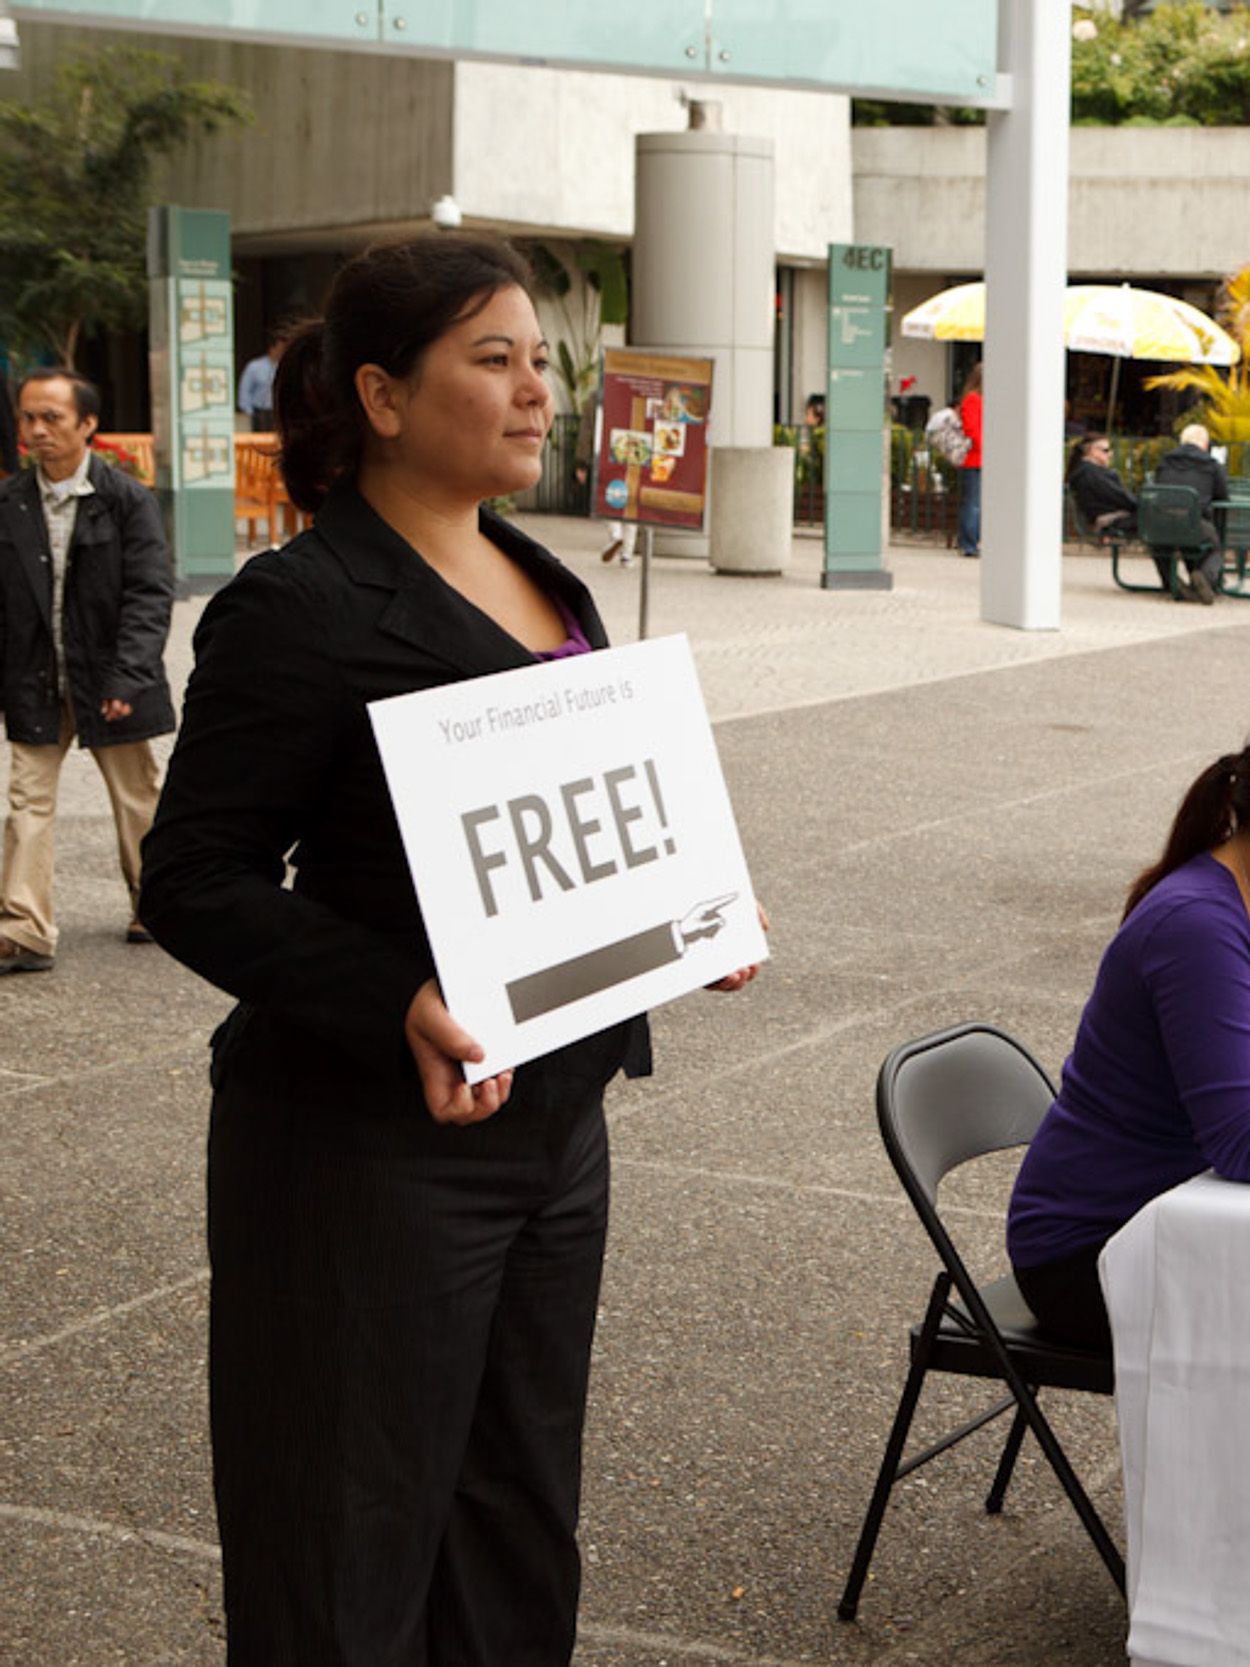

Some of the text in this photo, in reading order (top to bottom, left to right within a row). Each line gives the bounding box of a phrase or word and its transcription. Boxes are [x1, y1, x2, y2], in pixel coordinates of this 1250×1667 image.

[842, 246, 883, 271] 4EC
[437, 676, 634, 744] Your Financial Future is
[460, 758, 677, 919] FREE!
